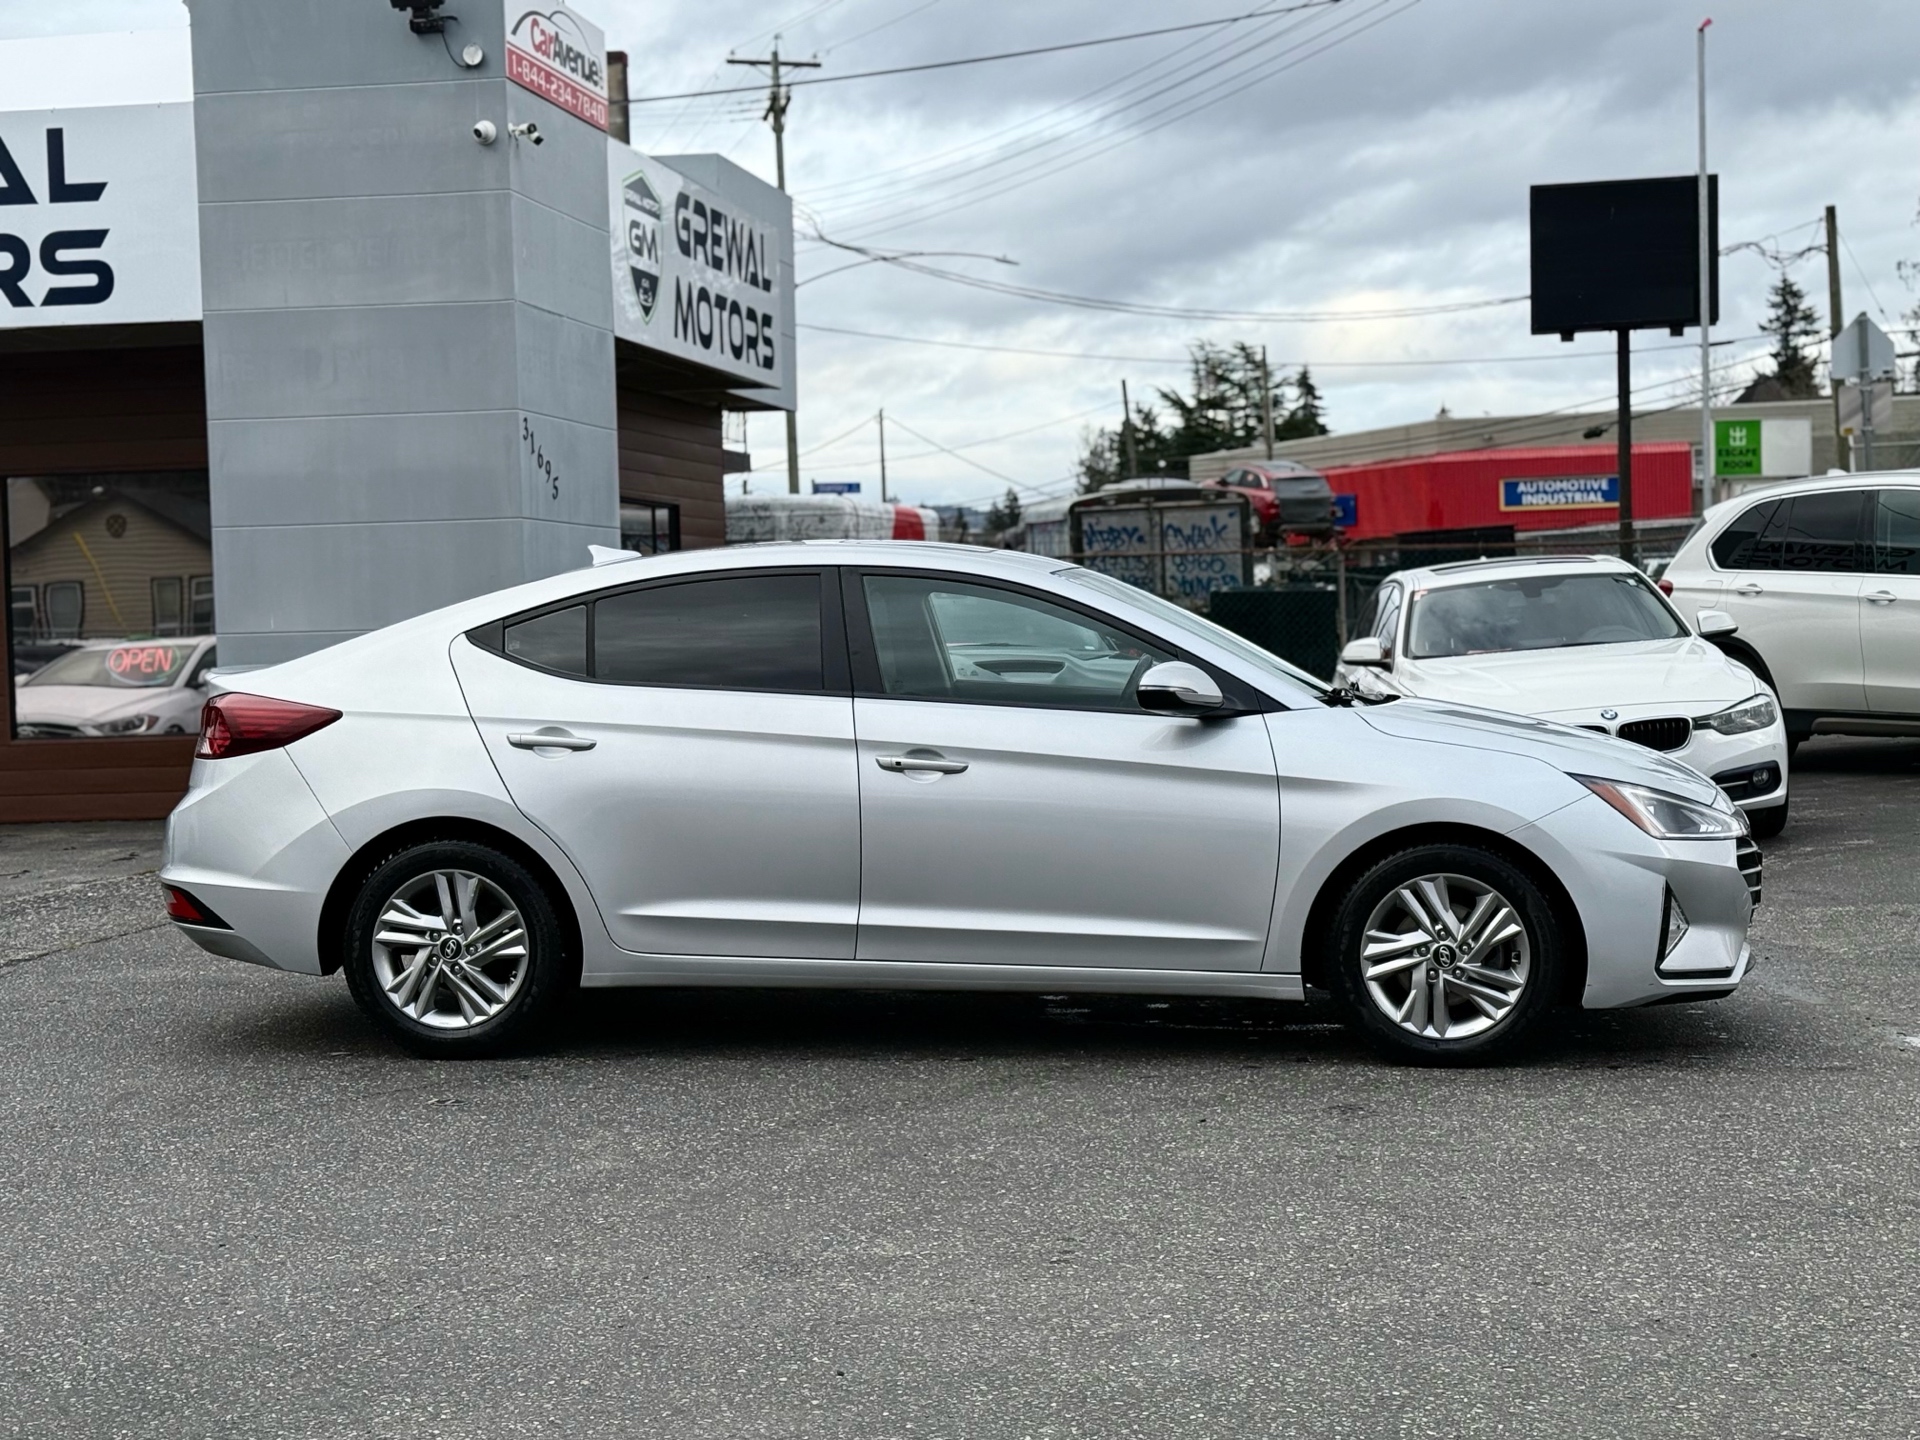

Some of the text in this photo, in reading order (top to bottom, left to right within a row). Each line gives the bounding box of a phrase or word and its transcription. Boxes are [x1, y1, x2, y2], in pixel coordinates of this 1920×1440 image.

[530, 17, 600, 87] CarAvenue
[511, 54, 605, 125] 1-844-234-7840
[629, 220, 658, 264] GM
[675, 191, 772, 293] GREWAL
[674, 275, 775, 371] MOTORS
[523, 416, 559, 501] 31695
[1718, 448, 1757, 457] ESCAPE
[1516, 479, 1609, 493] AUTOMOTIVE
[1521, 491, 1605, 505] INDUSTRIAL
[109, 647, 174, 674] OPEN
